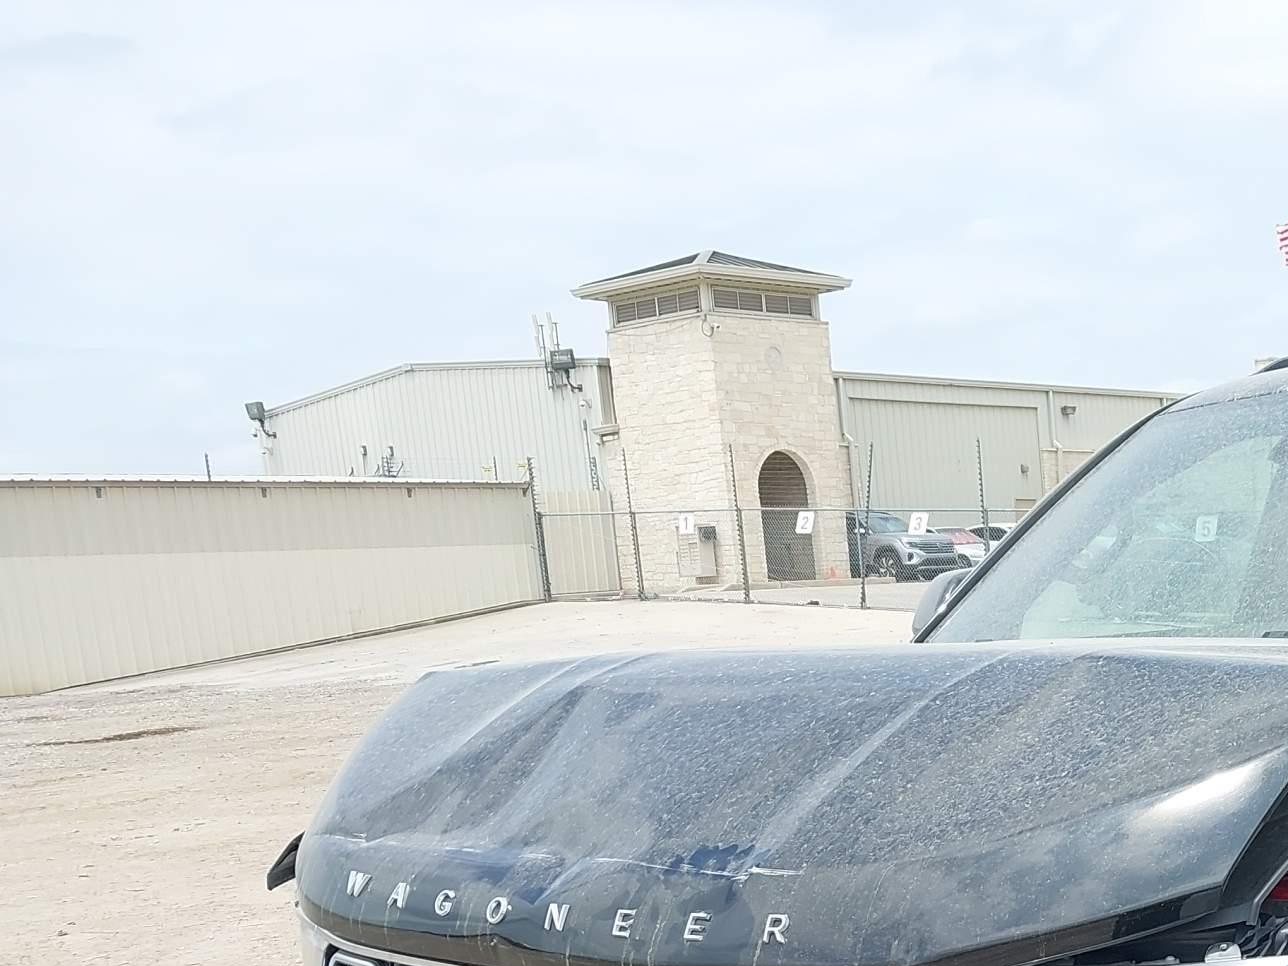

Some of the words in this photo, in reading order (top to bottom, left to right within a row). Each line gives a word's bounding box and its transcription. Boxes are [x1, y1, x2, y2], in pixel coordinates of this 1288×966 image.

[682, 516, 689, 530] 1
[800, 516, 809, 530] 2
[913, 517, 922, 531] 3
[1201, 520, 1211, 537] 5
[345, 869, 792, 945] WAGONEER
